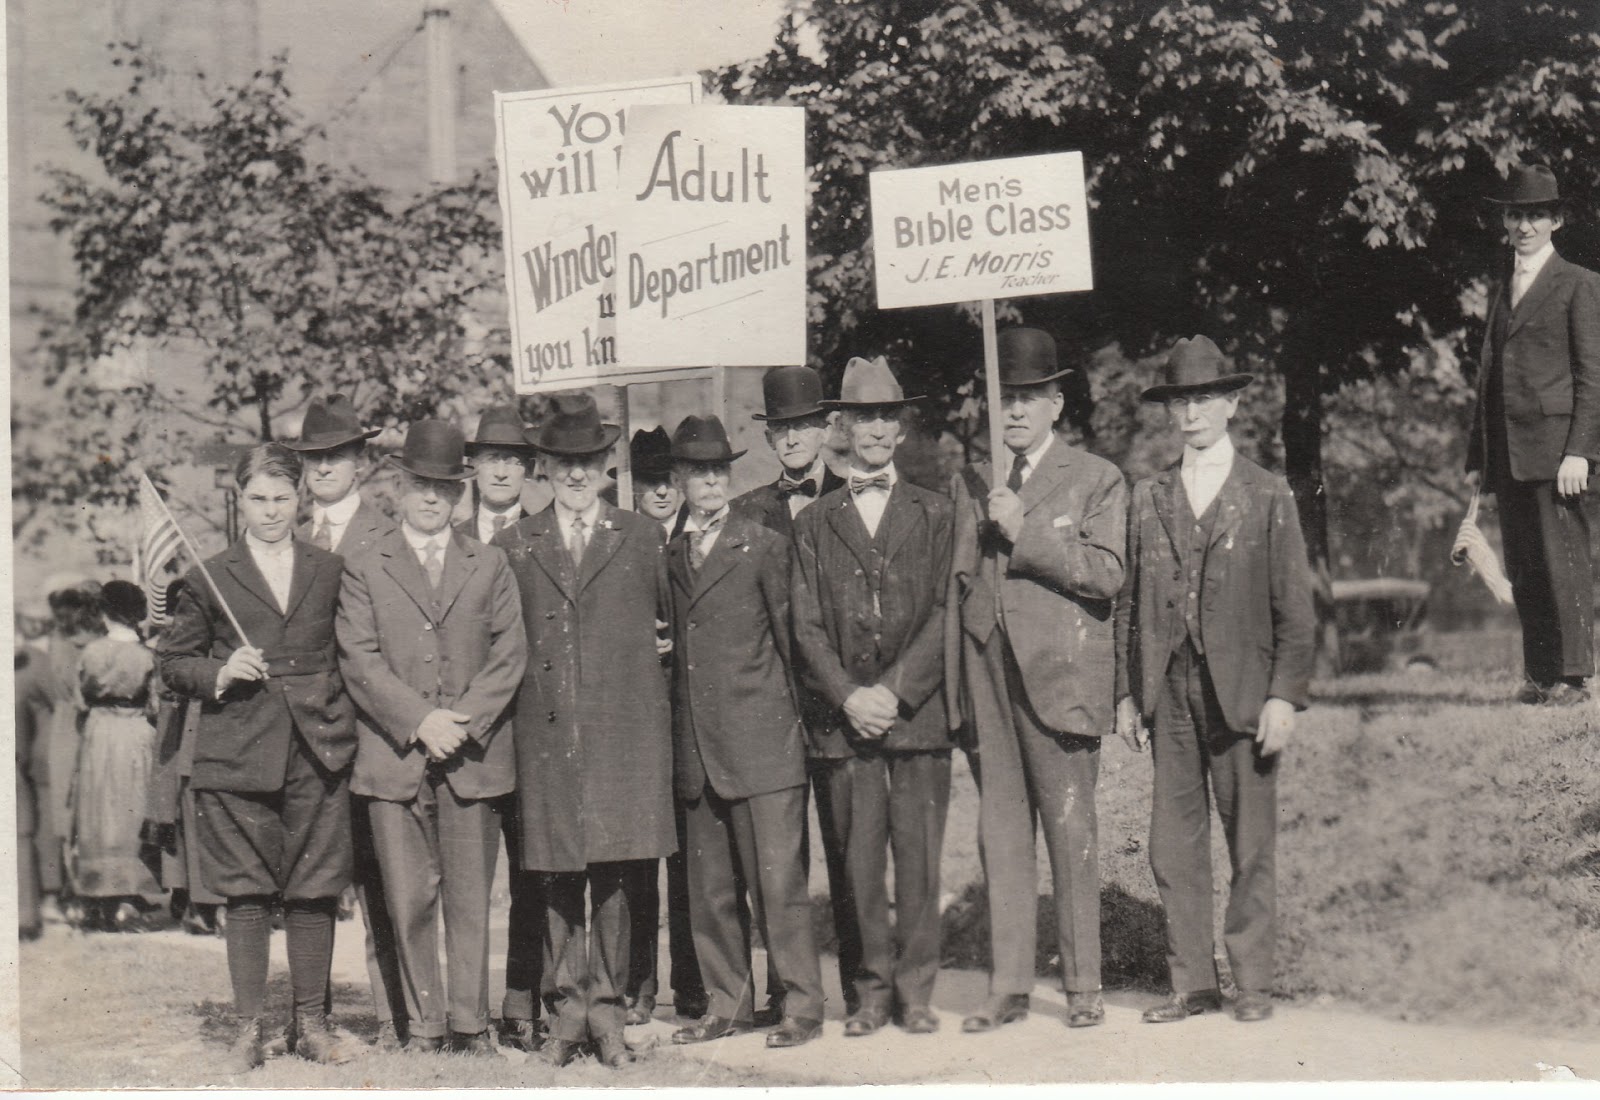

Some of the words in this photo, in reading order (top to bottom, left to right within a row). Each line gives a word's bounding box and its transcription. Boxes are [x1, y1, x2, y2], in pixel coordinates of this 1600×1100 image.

[520, 150, 598, 199] will
[635, 130, 772, 204] Adult
[894, 208, 974, 248] Bible
[985, 202, 1072, 237] Class
[628, 223, 791, 319] Department
[964, 243, 1054, 277] Morris
[524, 339, 573, 385] you
